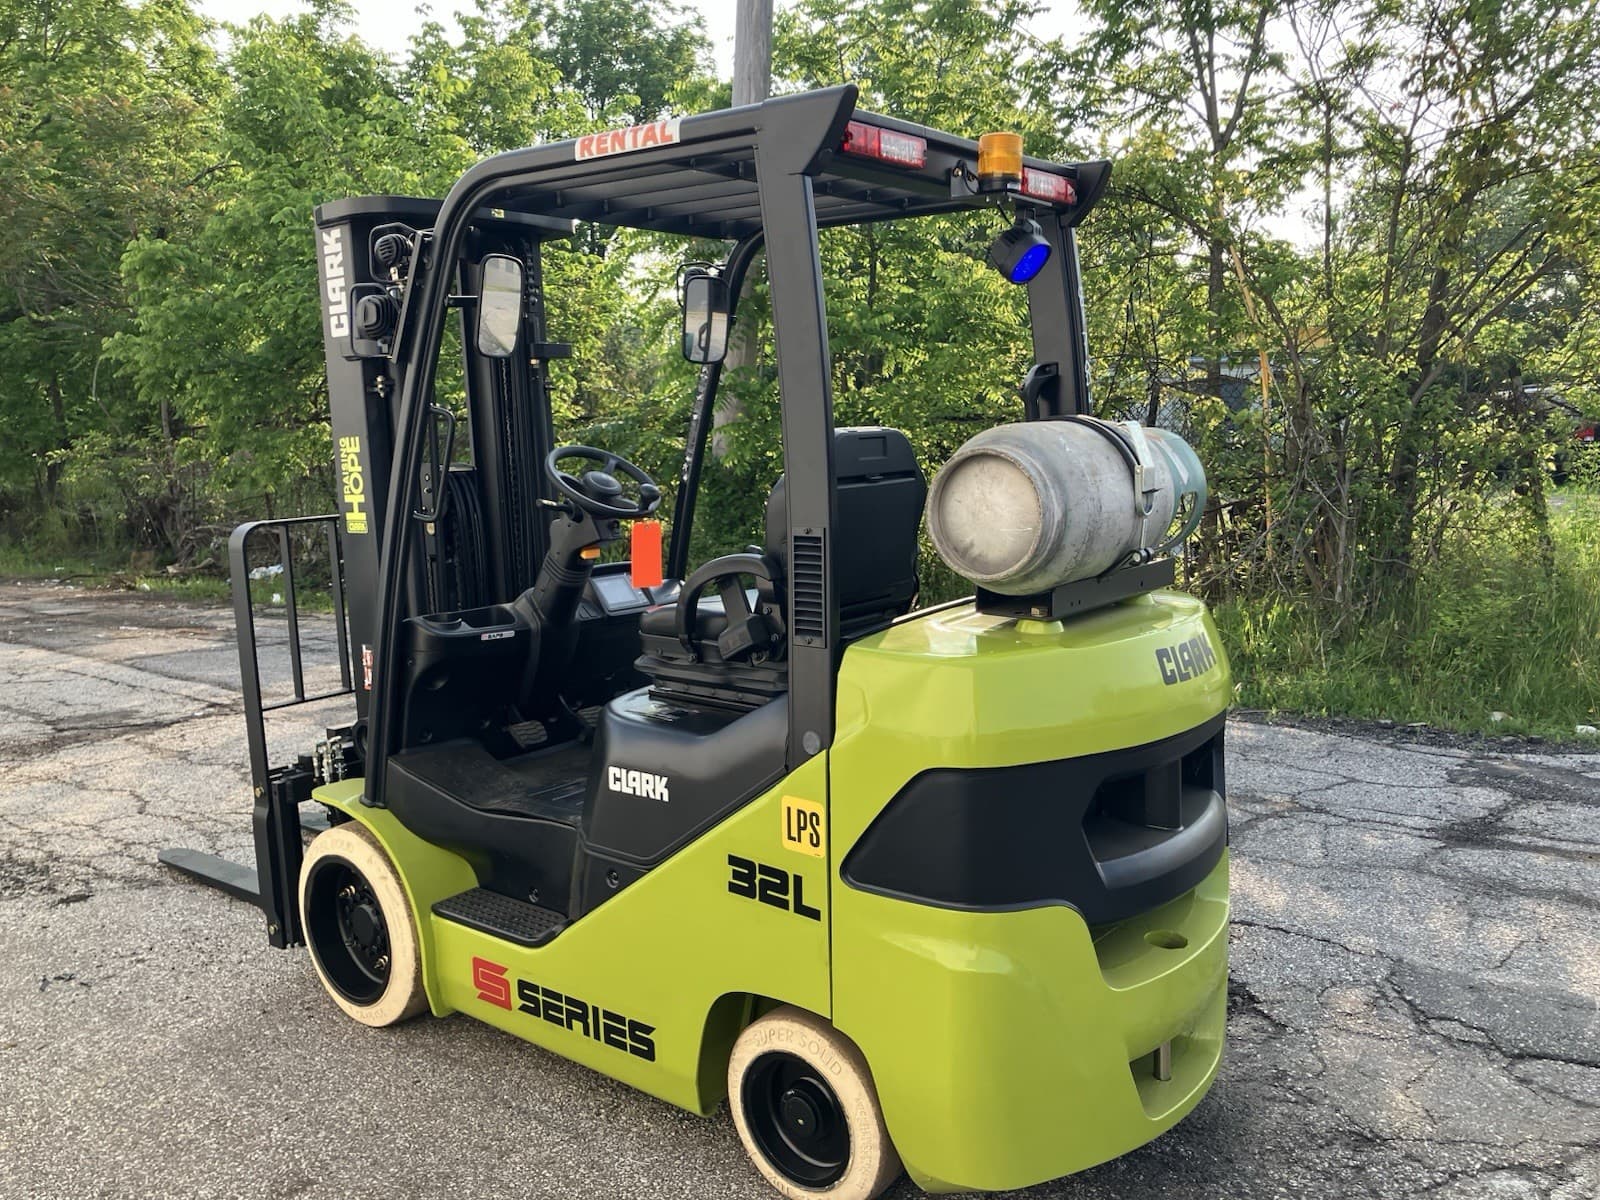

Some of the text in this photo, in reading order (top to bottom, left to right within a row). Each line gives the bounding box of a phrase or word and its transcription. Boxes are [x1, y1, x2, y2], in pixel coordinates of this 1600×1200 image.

[579, 121, 673, 158] RENTAL
[322, 228, 349, 338] CLARK
[339, 437, 351, 495] RAISING
[344, 436, 367, 521] HOPE
[1155, 632, 1217, 686] CLARK
[608, 766, 669, 802] CLARK
[787, 806, 820, 848] LPS
[728, 853, 821, 922] 32L
[472, 956, 656, 1063] S SERIES
[753, 1027, 842, 1076] SUPER SOLID
